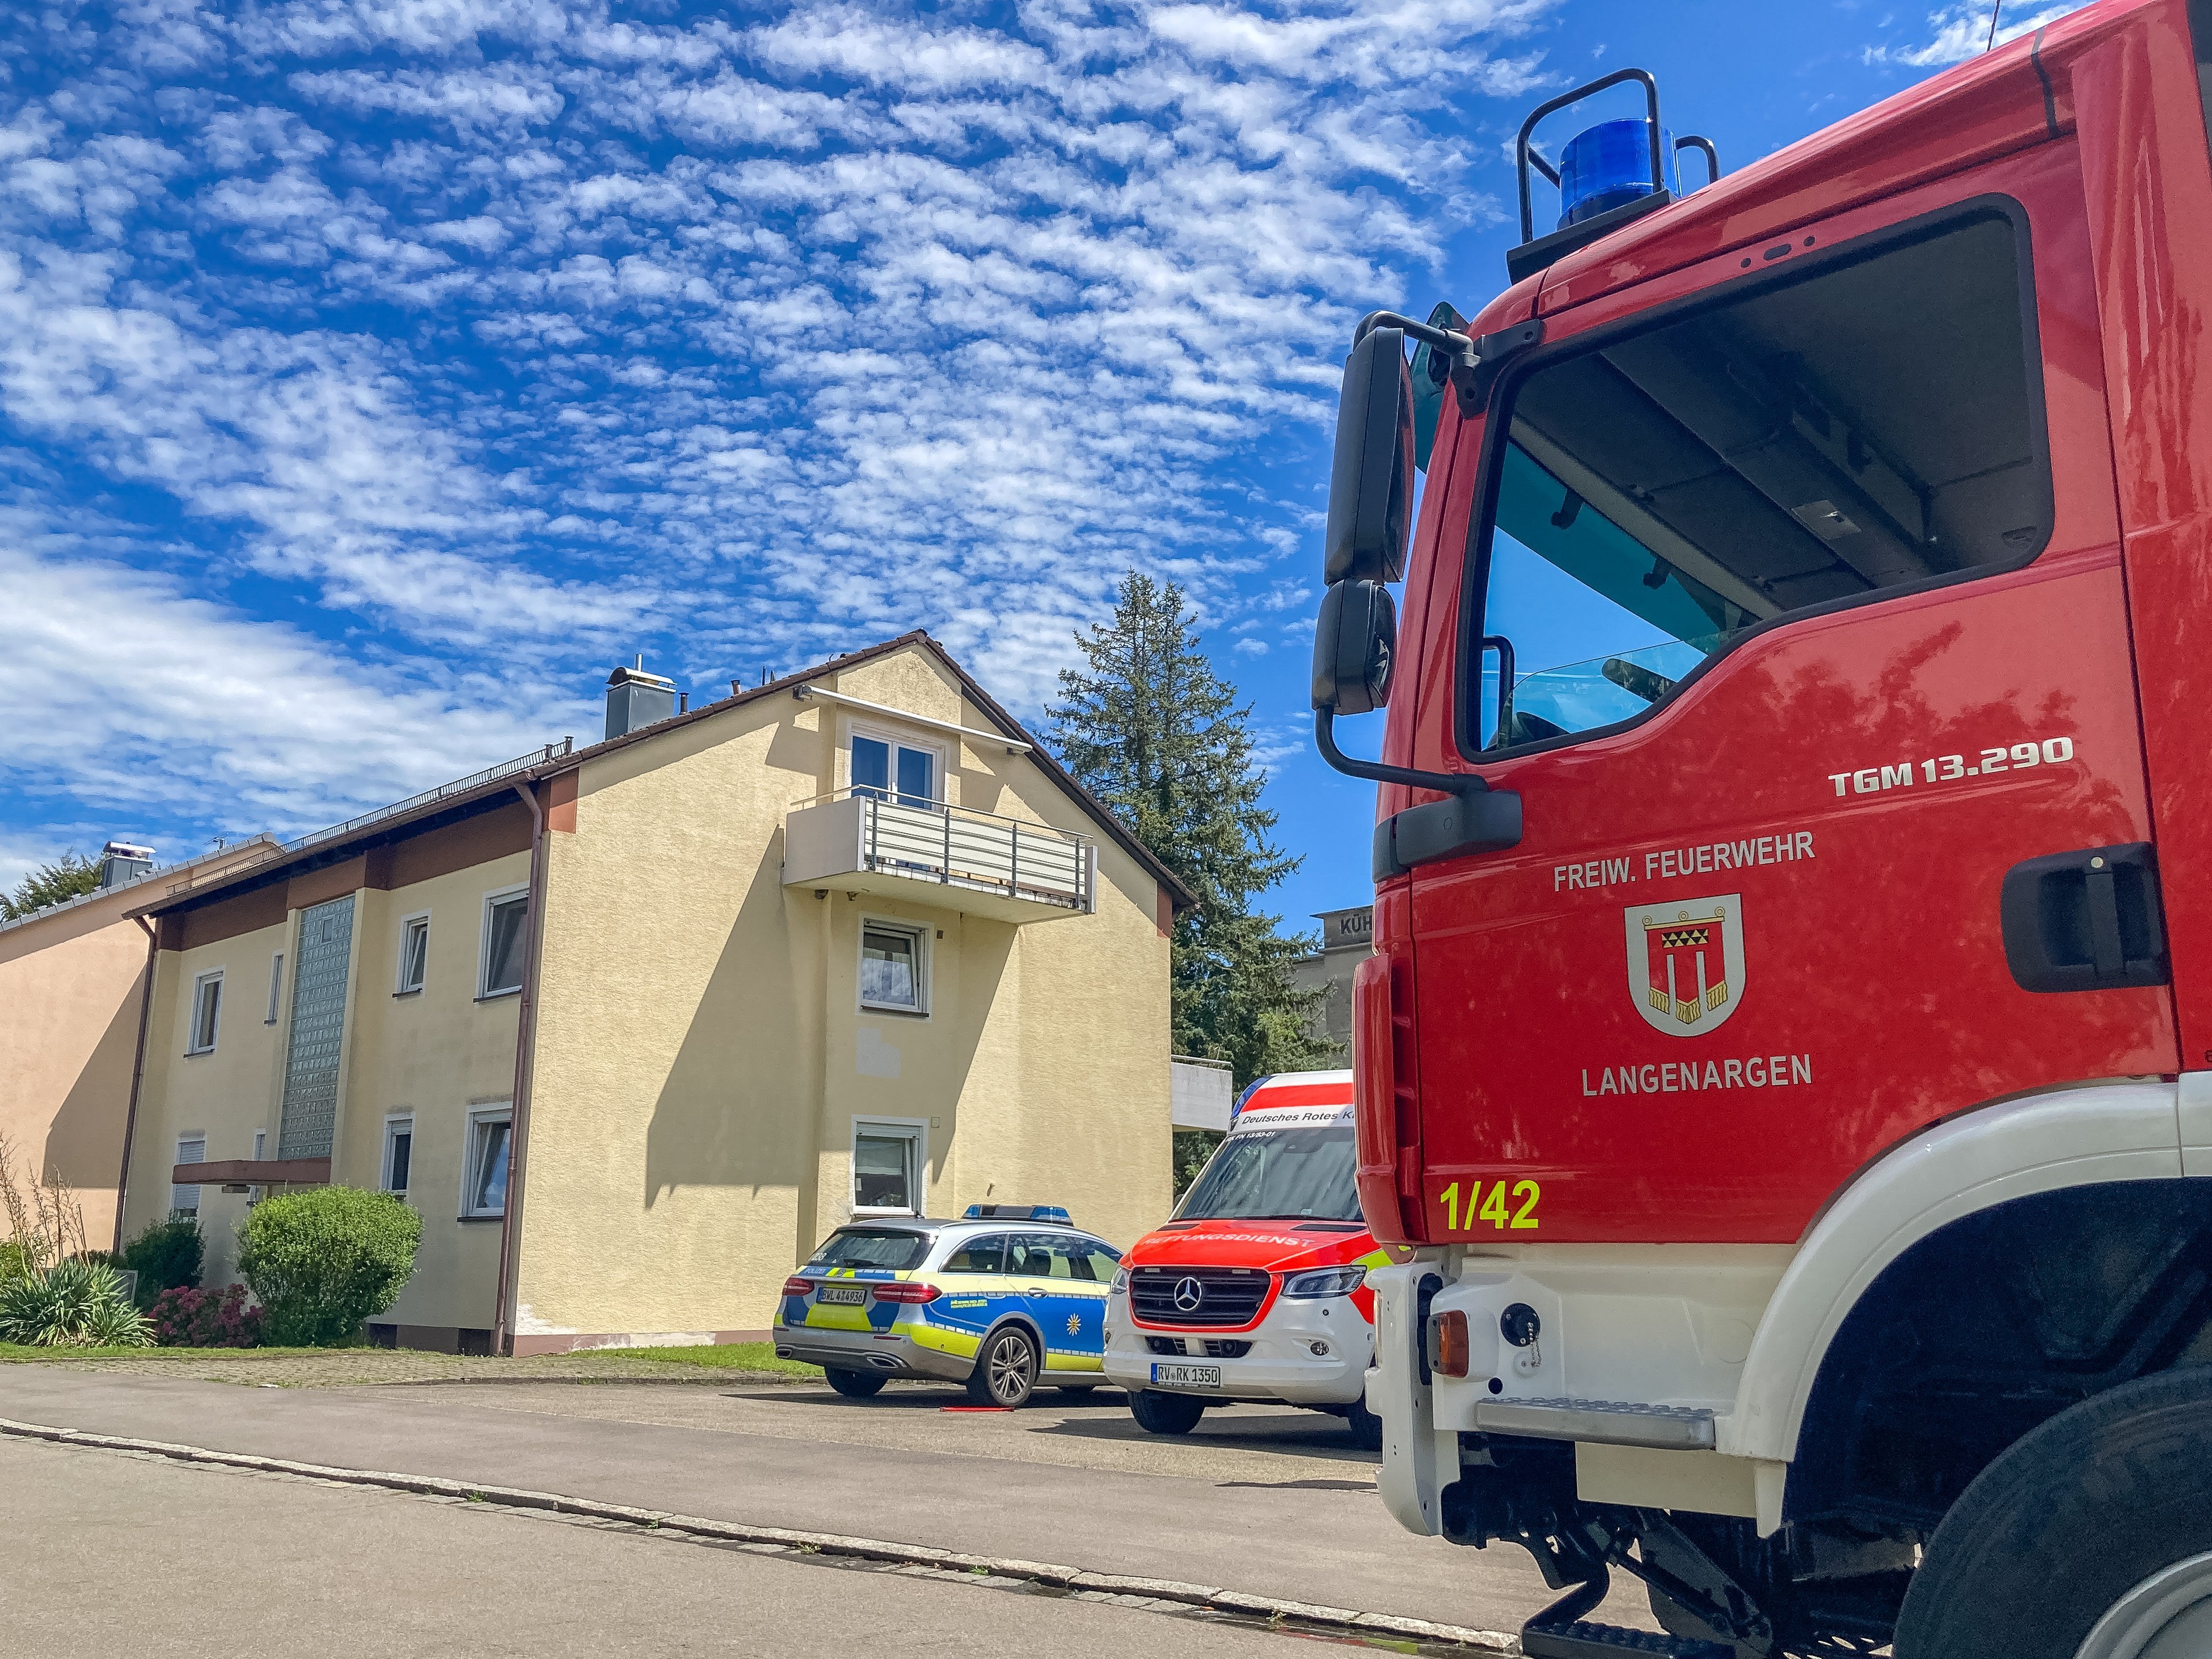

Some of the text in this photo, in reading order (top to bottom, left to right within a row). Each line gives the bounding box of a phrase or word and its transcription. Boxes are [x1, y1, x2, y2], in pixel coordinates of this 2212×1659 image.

[1828, 737, 2074, 797] TGM 13.290
[1554, 831, 1815, 892] FREIW. FEUERWEHR
[1582, 1054, 1812, 1096] LANGENARGEN
[1242, 1114, 1299, 1125] Deutsches
[1440, 1180, 1540, 1230] 1/42
[1143, 1234, 1314, 1247] RETTUNGSDIENST
[822, 1289, 835, 1301] BWL
[846, 1291, 863, 1302] 4936
[1158, 1366, 1218, 1383] RV RK 1350
